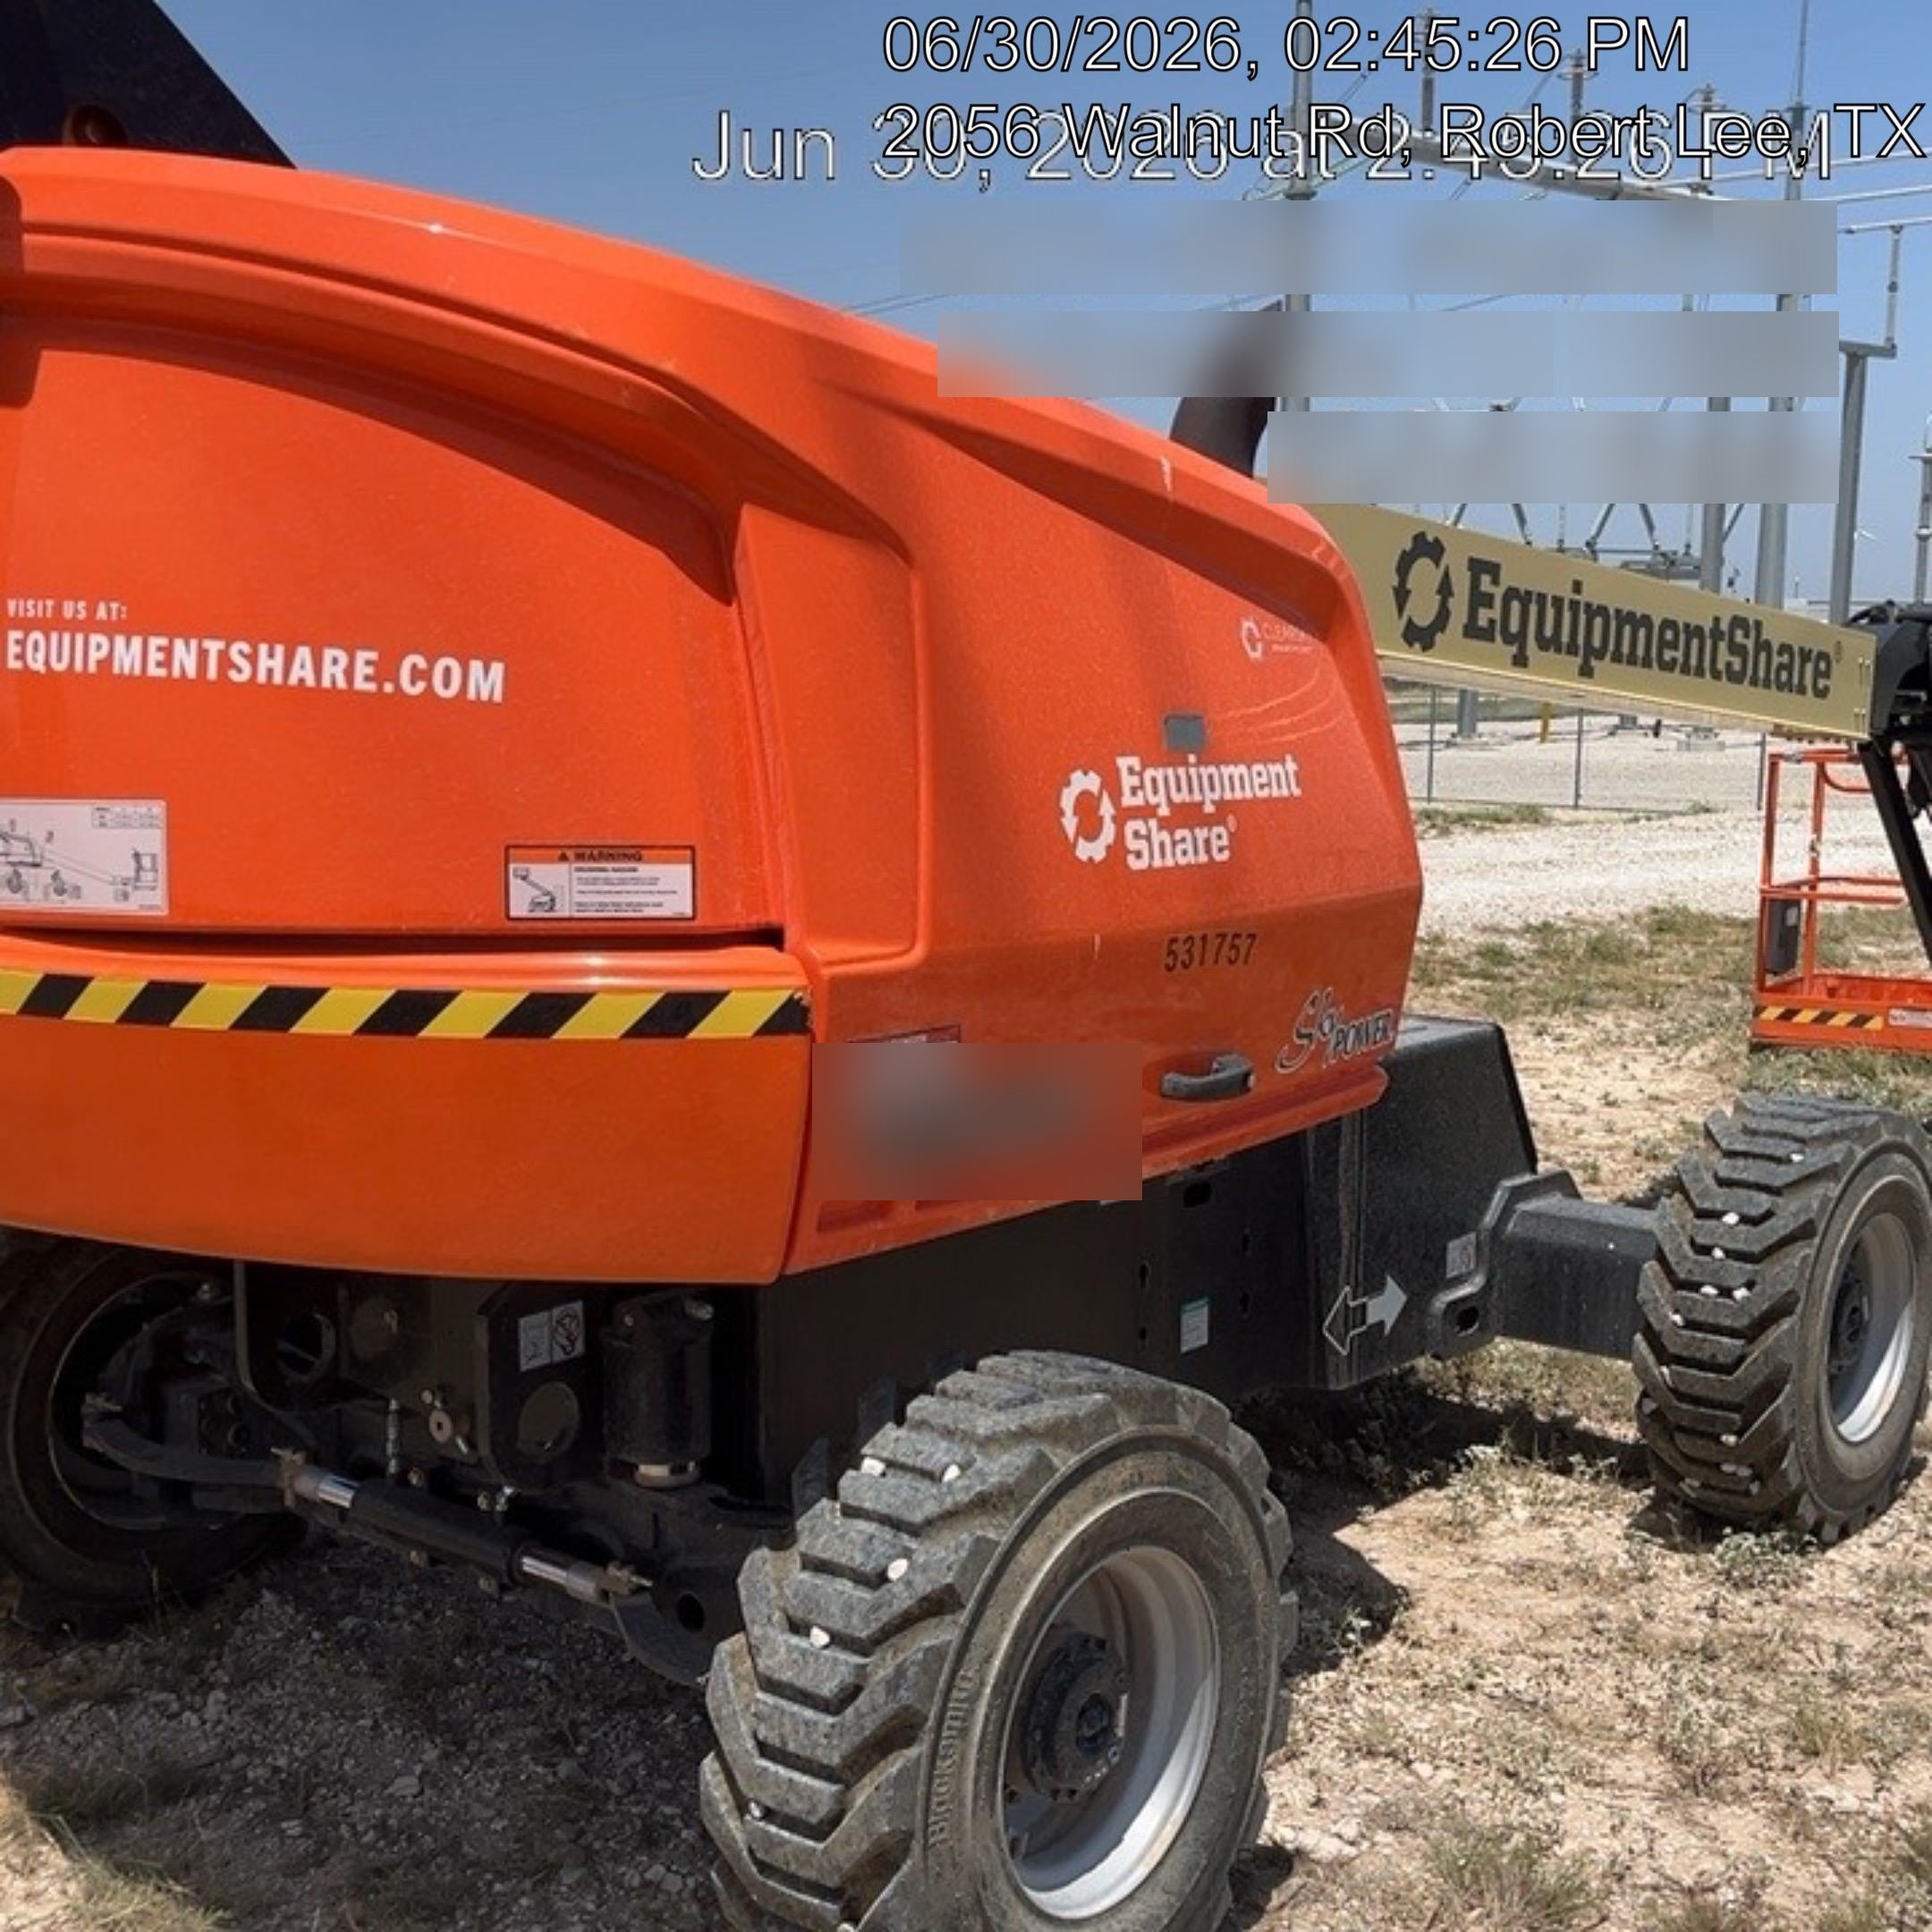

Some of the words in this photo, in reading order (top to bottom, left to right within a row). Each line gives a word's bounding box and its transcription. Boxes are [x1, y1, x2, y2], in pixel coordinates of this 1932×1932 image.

[6, 597, 55, 619] VISIT
[63, 599, 87, 620] US
[96, 601, 127, 621] AT:
[1462, 555, 1832, 699] EquipmentShare
[6, 630, 505, 704] EQUIPMENTSHARE.COM
[1115, 753, 1302, 815] Equipment
[573, 849, 642, 862] WARNING
[1124, 818, 1231, 871] Share
[1164, 933, 1258, 972] 531757
